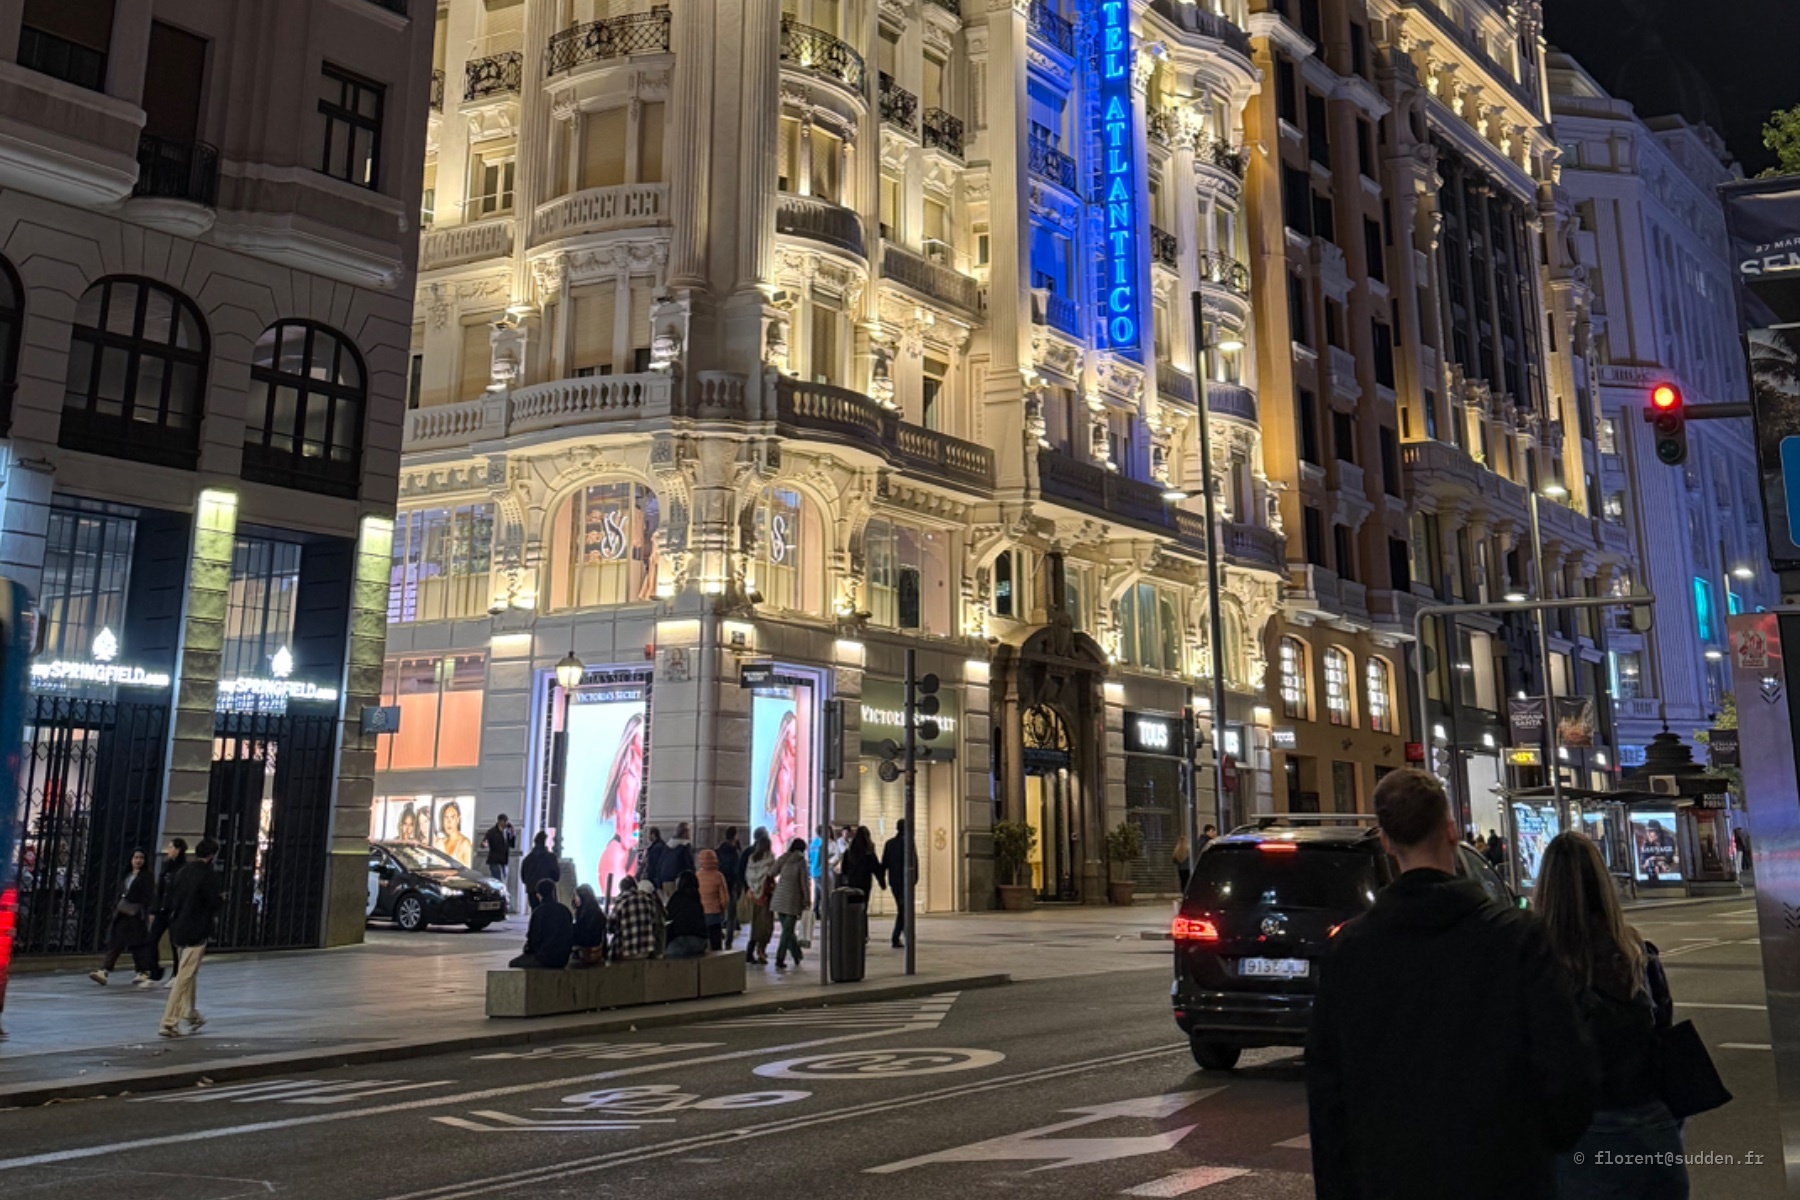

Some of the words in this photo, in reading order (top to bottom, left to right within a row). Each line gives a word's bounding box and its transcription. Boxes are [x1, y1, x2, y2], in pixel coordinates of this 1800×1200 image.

[1105, 96, 1133, 342] ATLANTICO
[576, 691, 613, 702] VICTORIA'S
[615, 690, 641, 700] SECRET
[1138, 721, 1168, 748] TOUS
